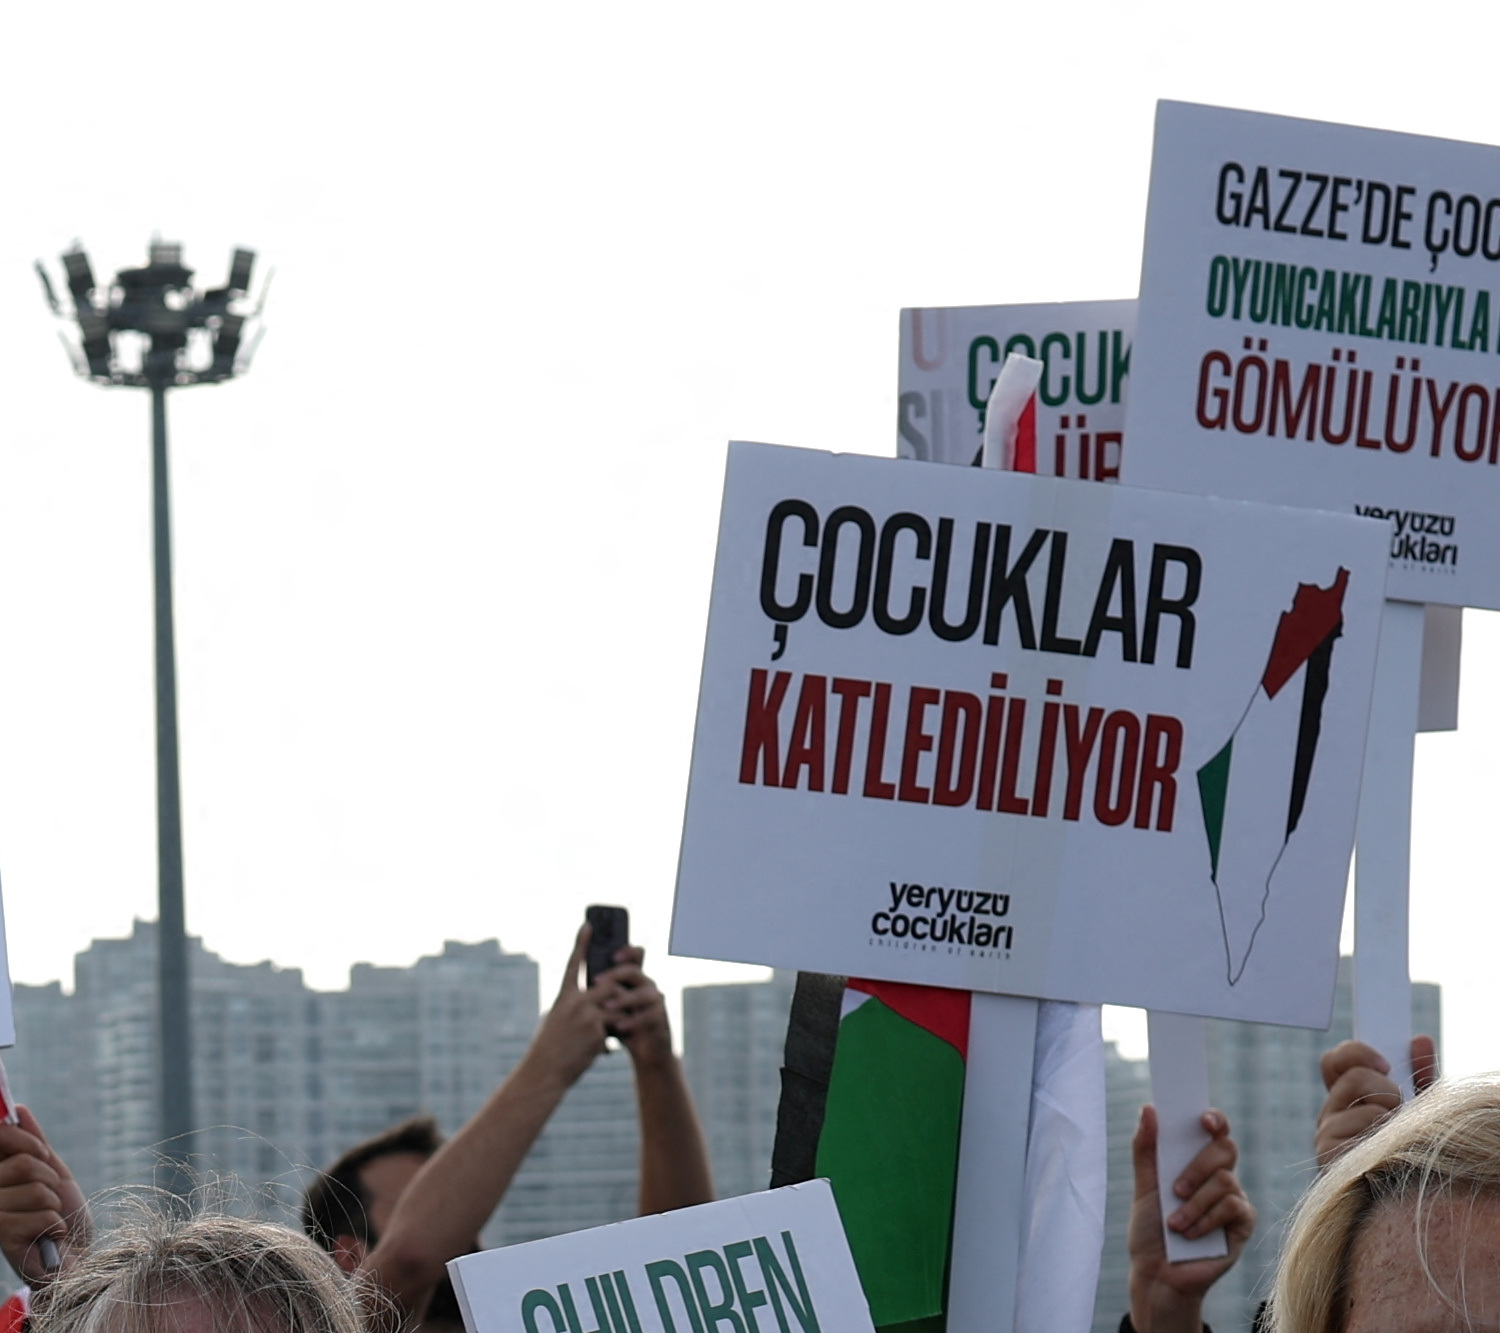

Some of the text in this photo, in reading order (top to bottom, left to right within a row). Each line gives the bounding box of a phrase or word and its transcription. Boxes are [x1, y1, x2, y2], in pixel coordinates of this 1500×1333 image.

[1206, 254, 1490, 358] OYUNCAKLARIYLA
[759, 498, 1203, 670] ÇOCUKLAR
[1391, 534, 1459, 566] ukları
[738, 668, 1184, 833] KATLEDİLİYOR
[889, 882, 1010, 917] yeryüzü
